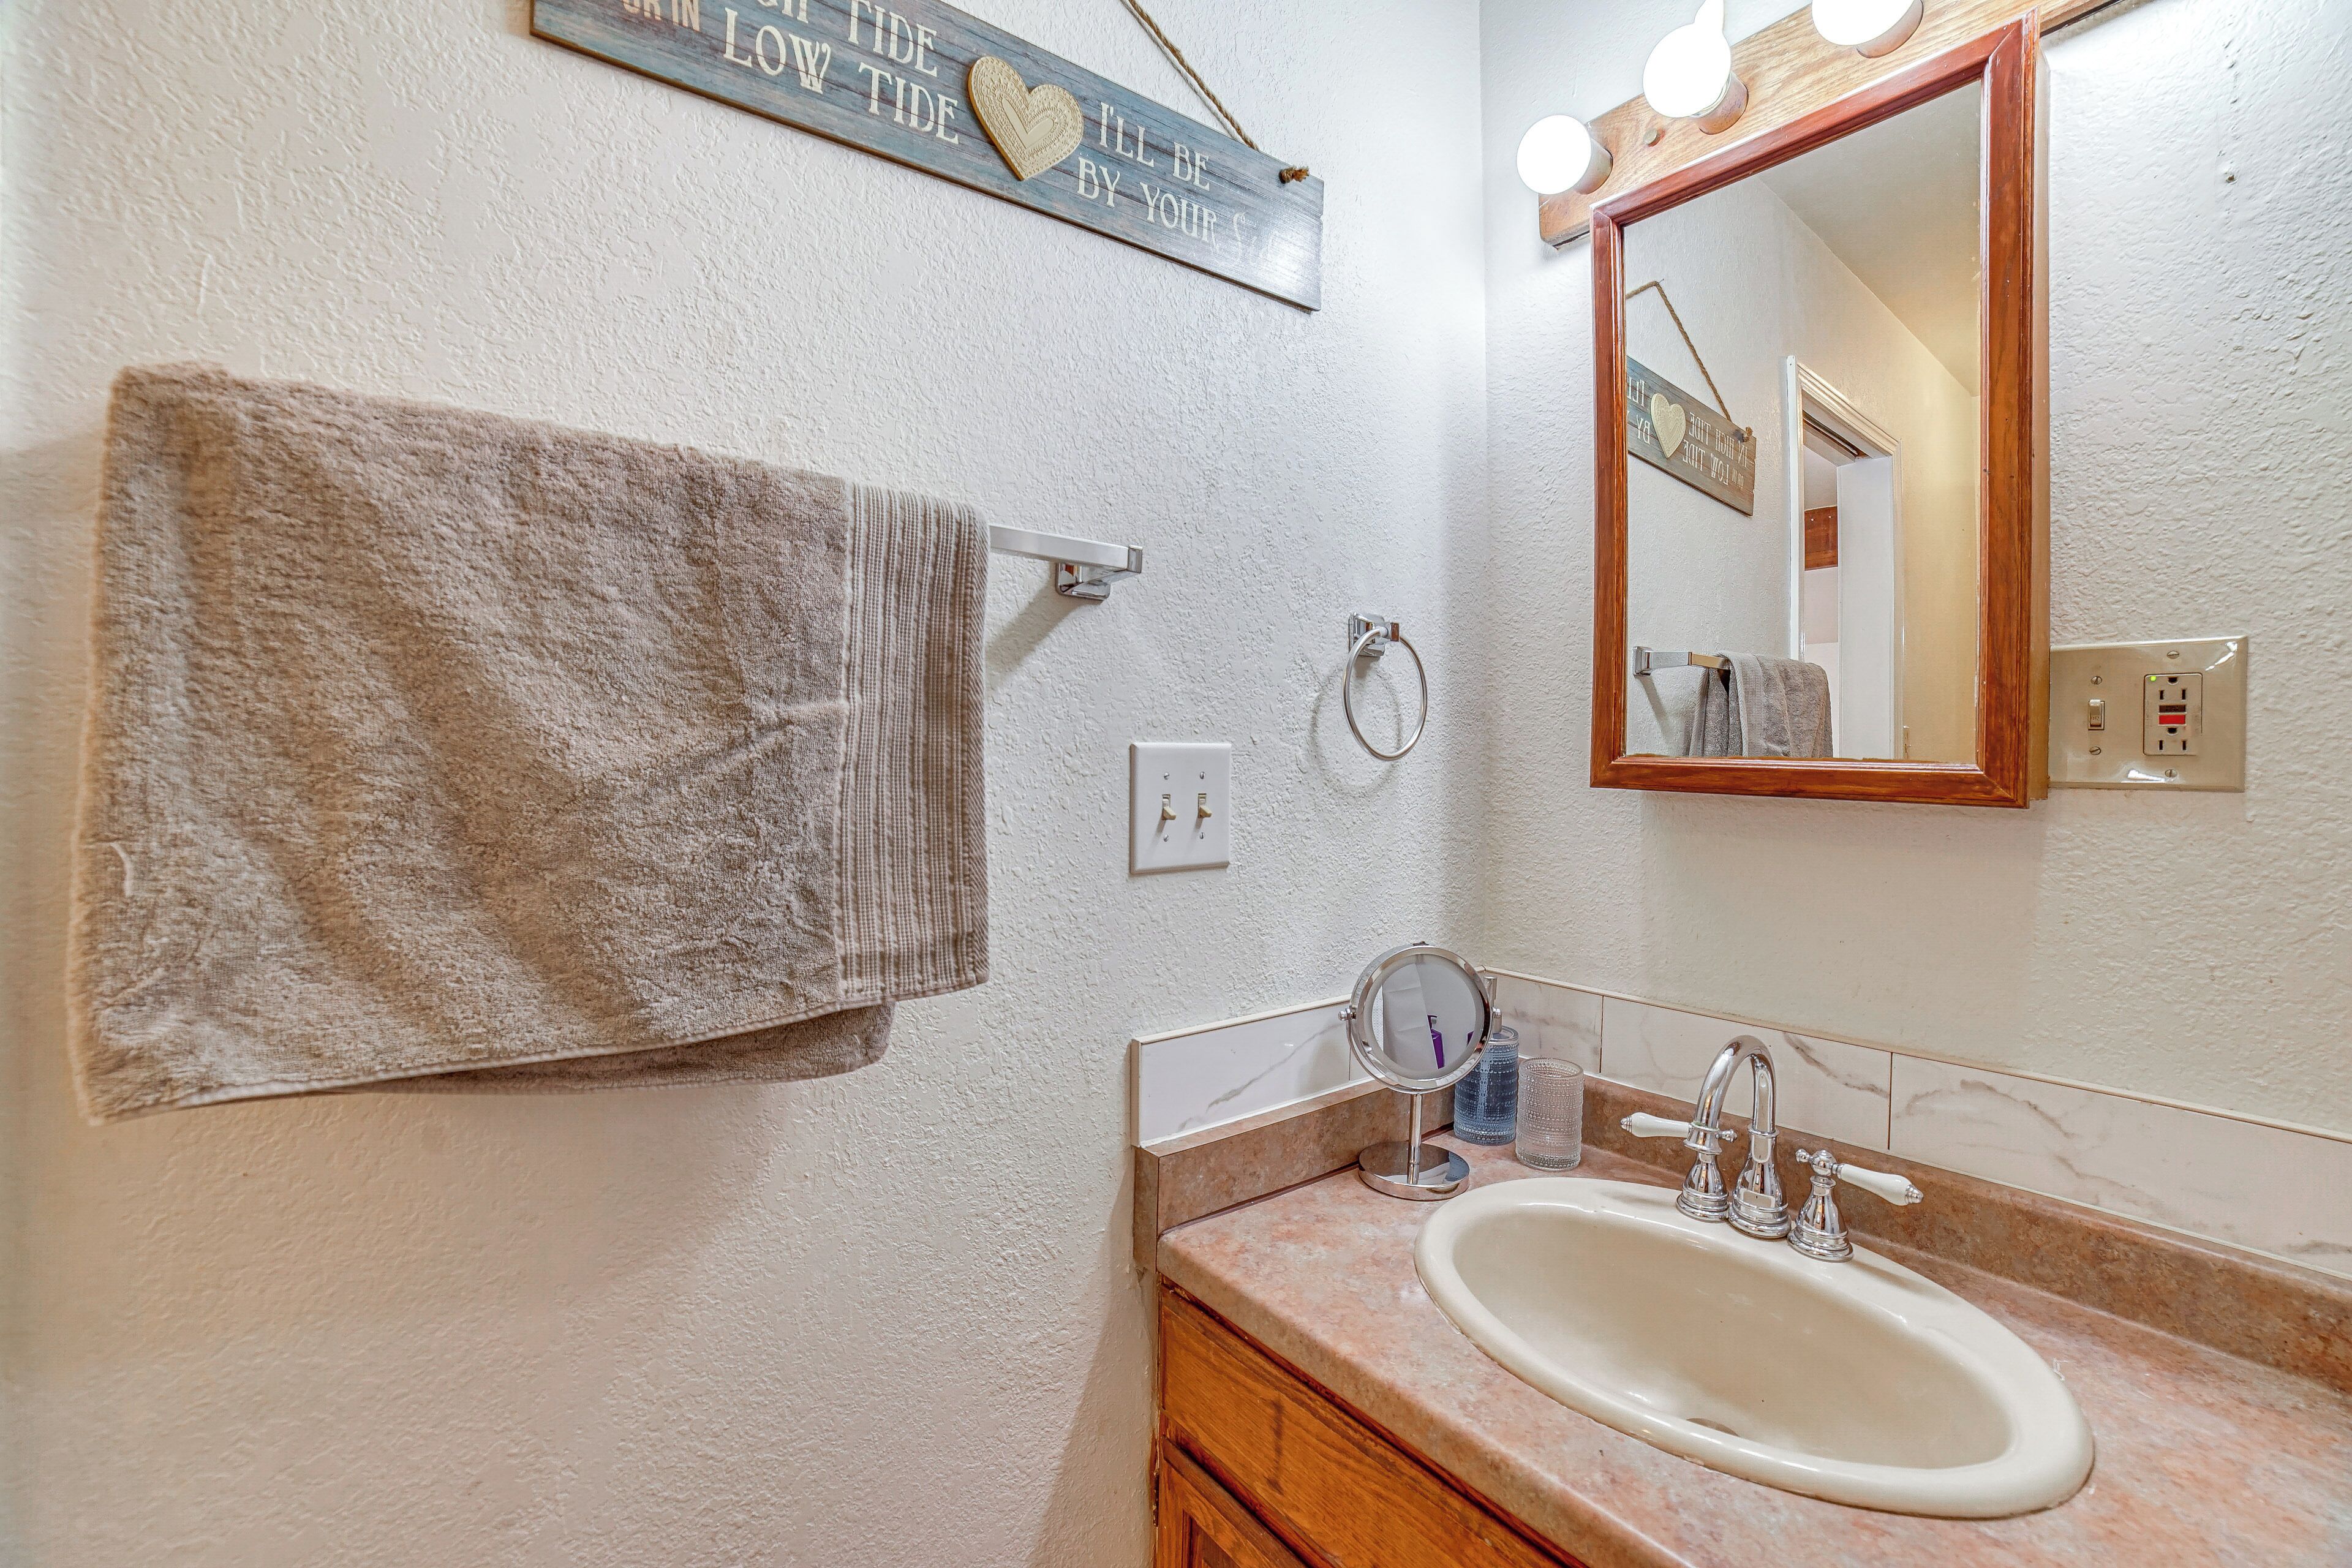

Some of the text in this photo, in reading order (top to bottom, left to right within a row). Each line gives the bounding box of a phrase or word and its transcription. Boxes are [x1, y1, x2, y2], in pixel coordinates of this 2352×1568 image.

[671, 0, 700, 31] IN
[723, 7, 831, 94] LOW
[858, 62, 959, 145] TIDE
[848, 0, 938, 77] TIDE
[1099, 101, 1210, 191] I'LL BE
[1076, 157, 1120, 208] BY
[1139, 182, 1219, 252] YOUR
